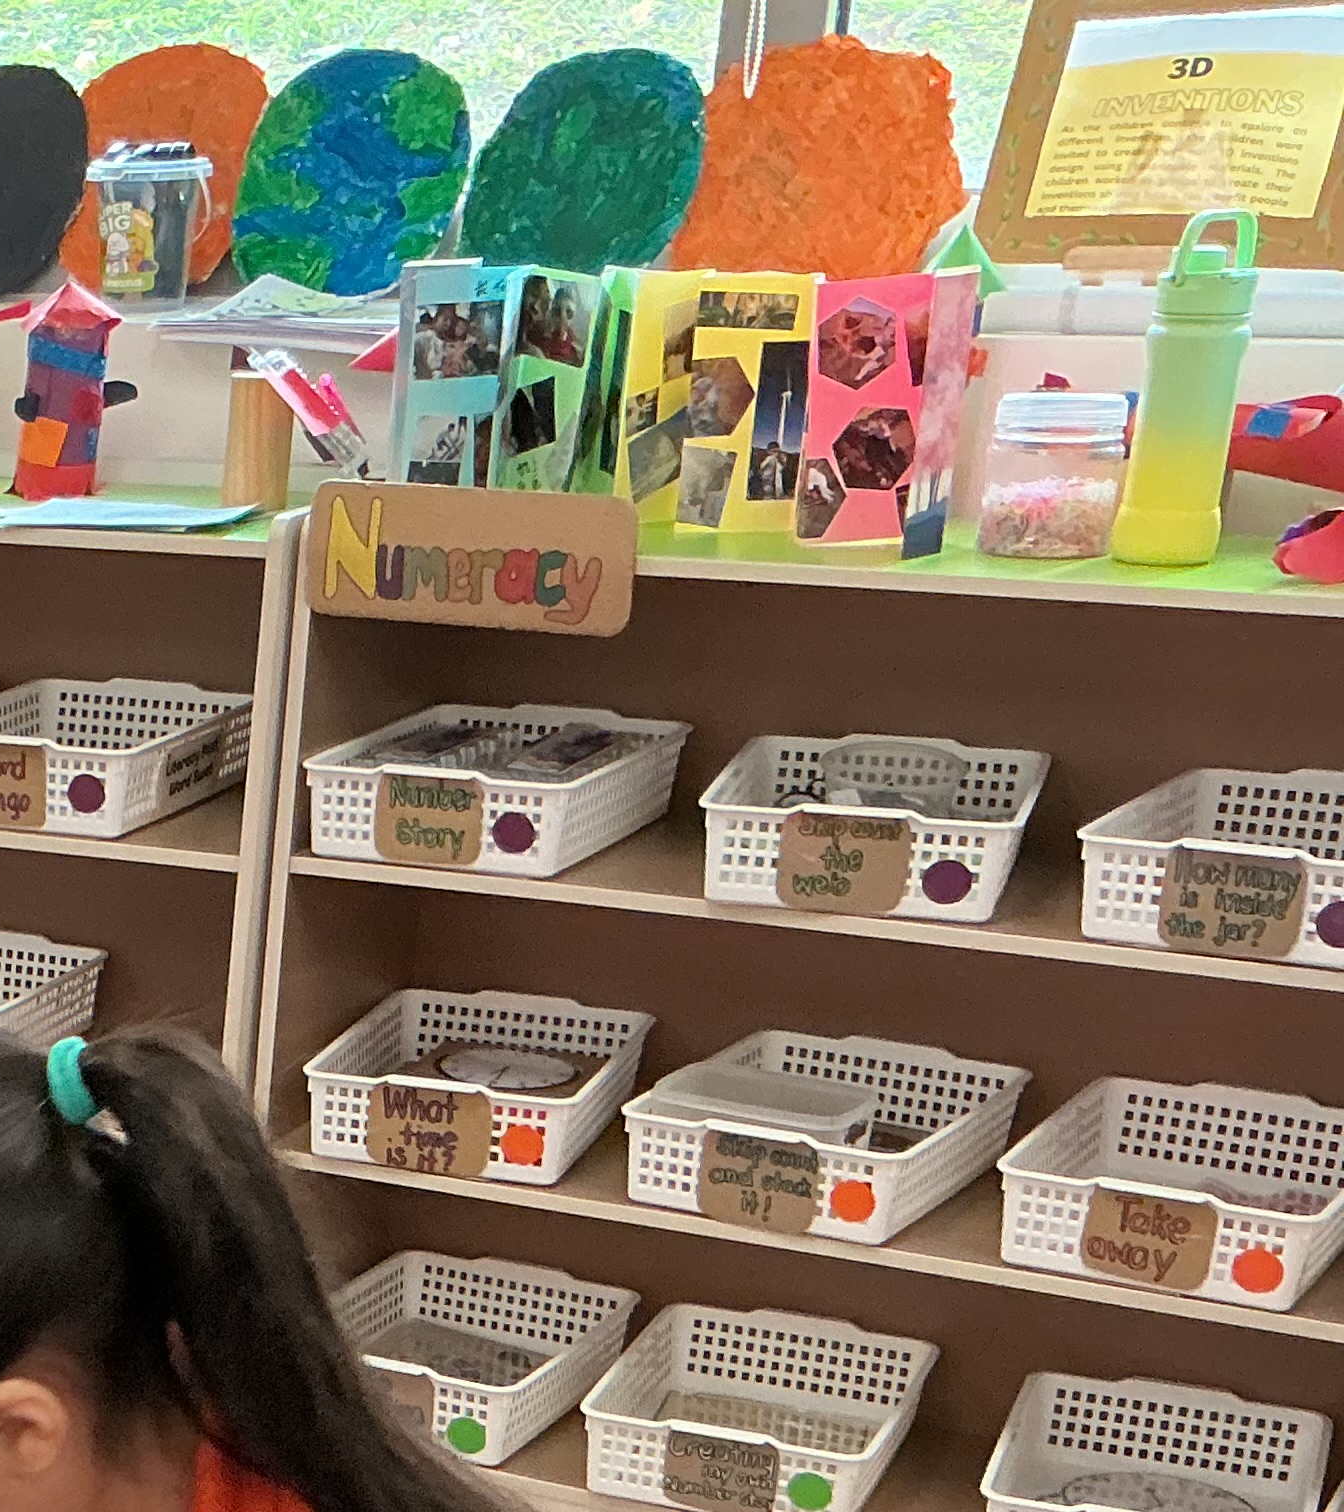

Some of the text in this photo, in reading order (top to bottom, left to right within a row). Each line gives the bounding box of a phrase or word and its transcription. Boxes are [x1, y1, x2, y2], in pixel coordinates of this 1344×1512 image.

[1167, 57, 1213, 80] 3D
[1091, 87, 1304, 119] INVENTIONS
[1109, 121, 1153, 130] children
[99, 214, 131, 240] BIG
[322, 495, 602, 626] Numeracy
[389, 775, 478, 813] Number
[395, 817, 466, 860] Story
[819, 845, 864, 874] the
[1174, 848, 1230, 885] How
[792, 871, 852, 898] web
[1178, 884, 1293, 922] is inside
[1164, 911, 1268, 947] the jar?
[383, 1085, 460, 1125] What
[399, 1121, 459, 1152] time
[385, 1137, 457, 1173] is it?
[708, 1164, 754, 1188] and
[1115, 1194, 1192, 1246] Take
[1085, 1234, 1178, 1284] away
[670, 1437, 775, 1479] Creating
